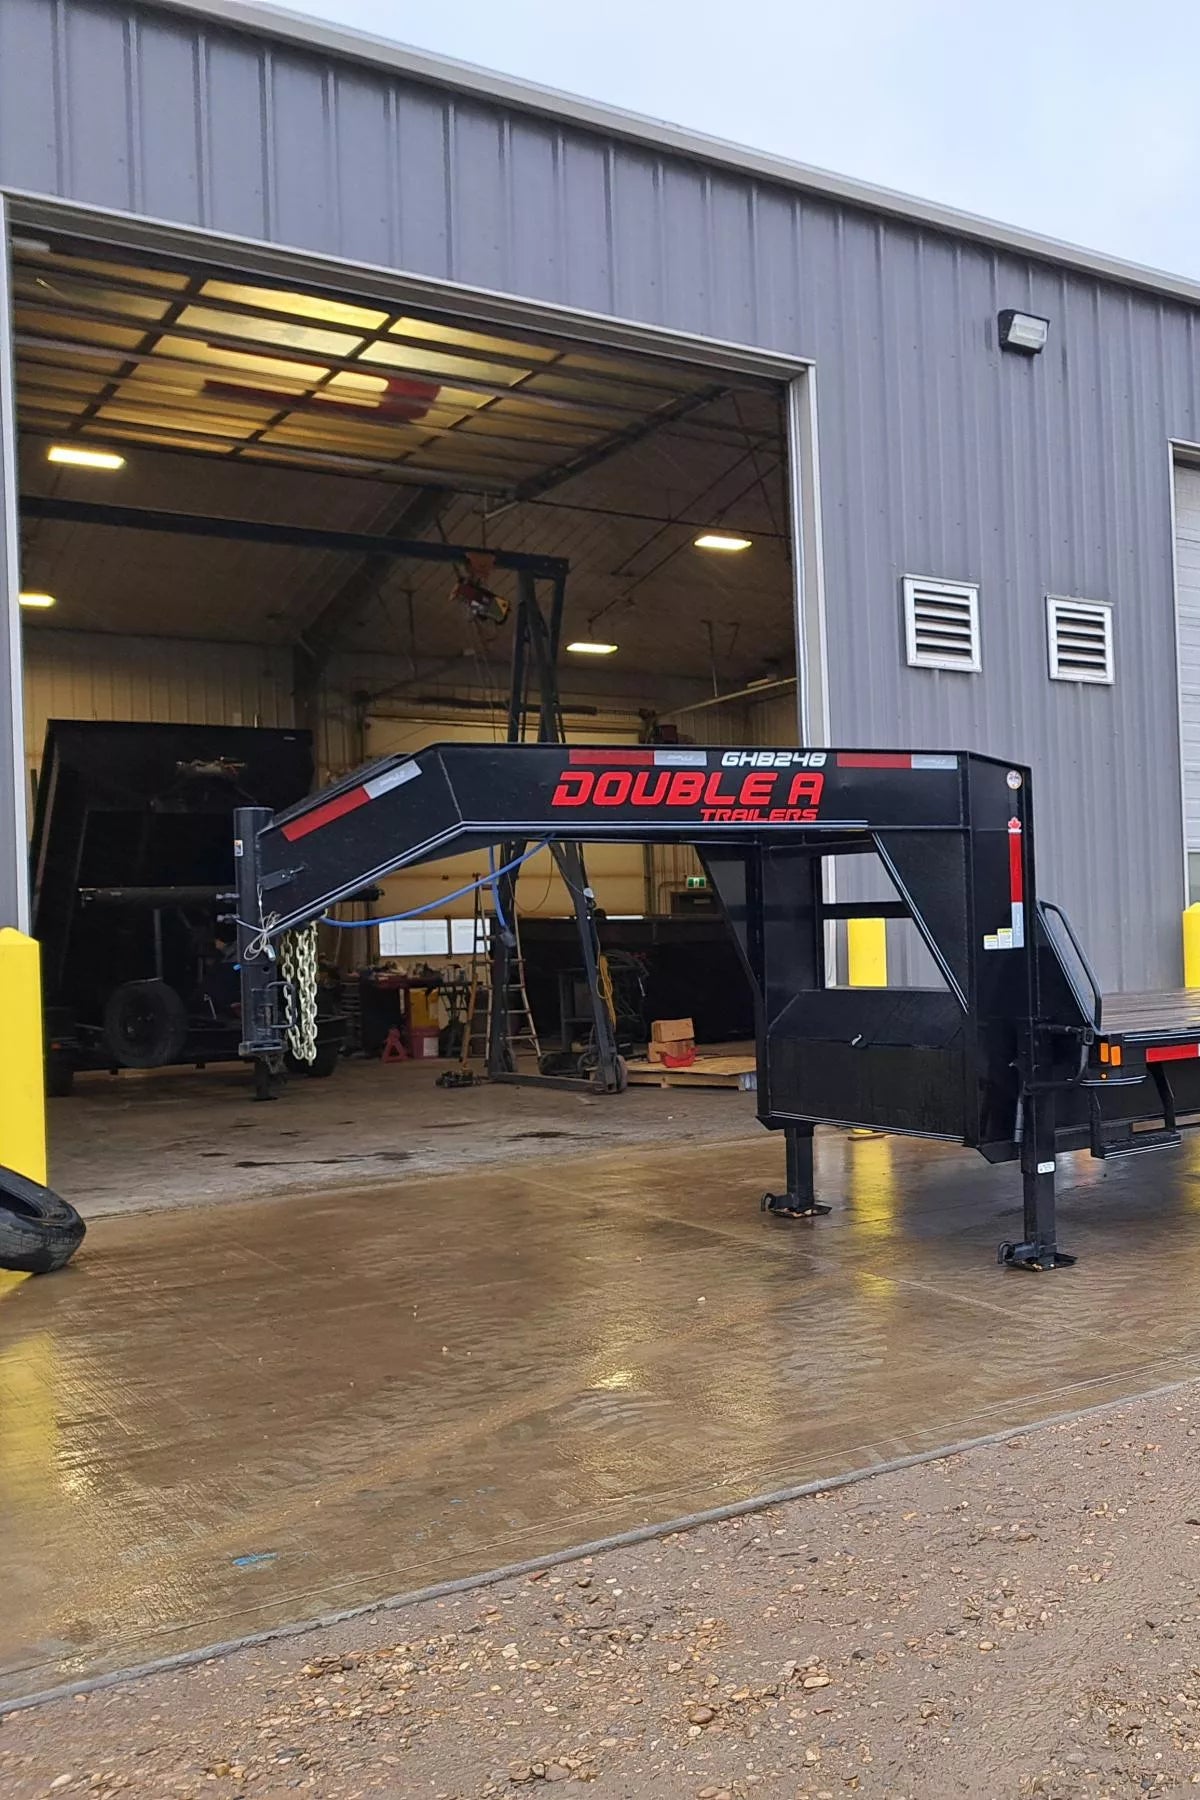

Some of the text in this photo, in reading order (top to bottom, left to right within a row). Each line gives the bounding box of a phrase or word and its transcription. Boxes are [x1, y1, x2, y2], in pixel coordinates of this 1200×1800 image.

[721, 751, 827, 767] GHB248
[551, 771, 824, 805] DOUBLE A
[700, 808, 818, 822] TRAILERS
